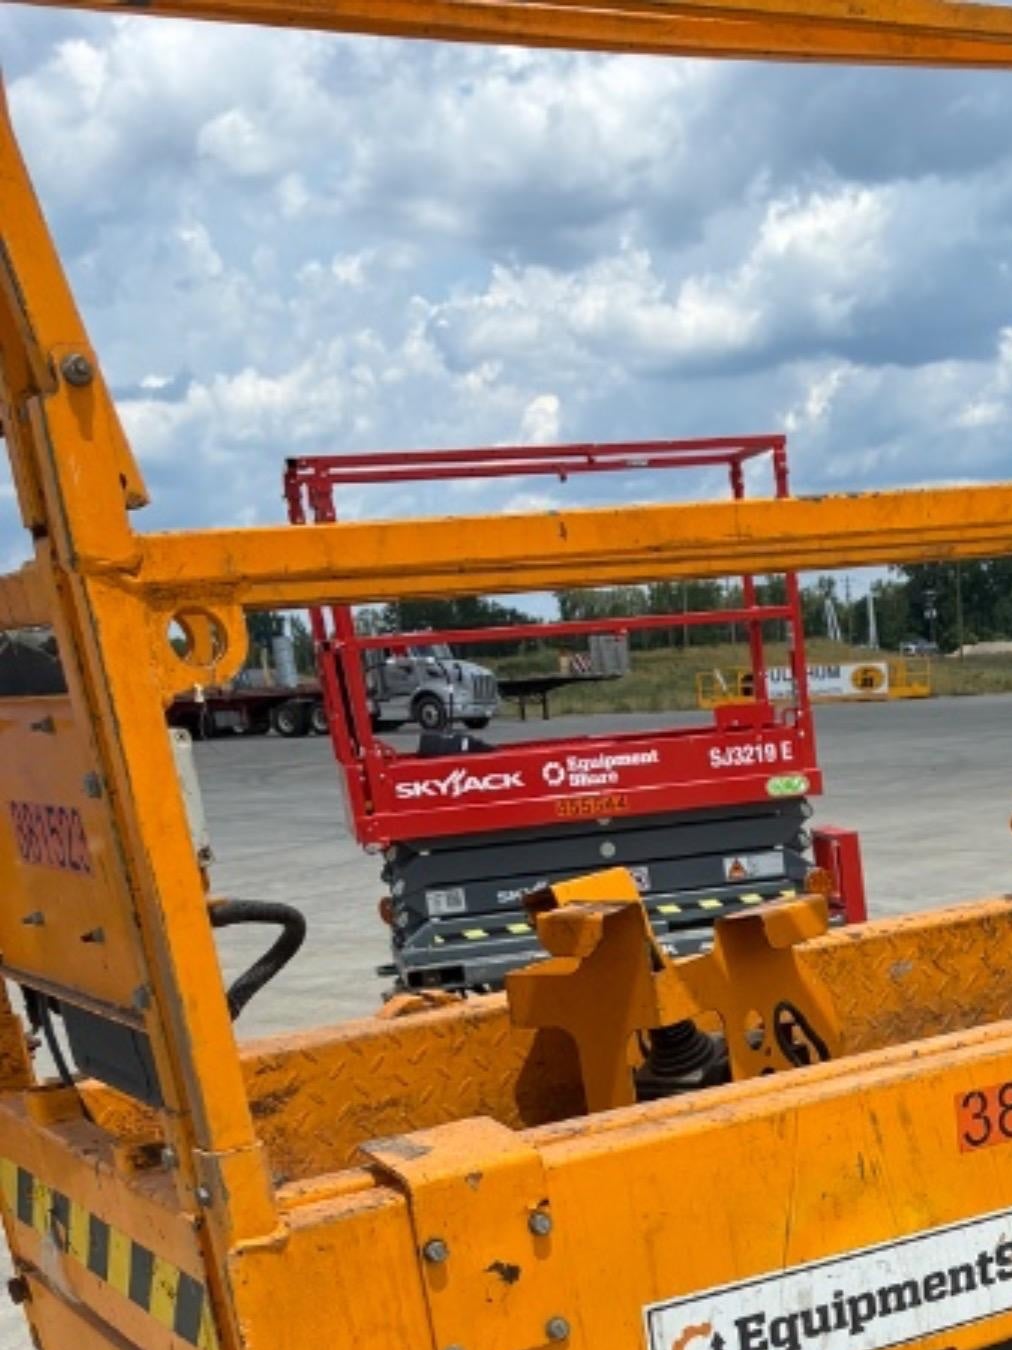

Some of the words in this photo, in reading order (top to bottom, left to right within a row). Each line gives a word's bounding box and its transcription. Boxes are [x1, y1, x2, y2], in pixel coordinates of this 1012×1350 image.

[566, 749, 660, 773] Equipment
[709, 742, 778, 769] SJ3219
[781, 740, 794, 761] E
[395, 767, 526, 799] SKYJACK
[569, 771, 619, 787] Share
